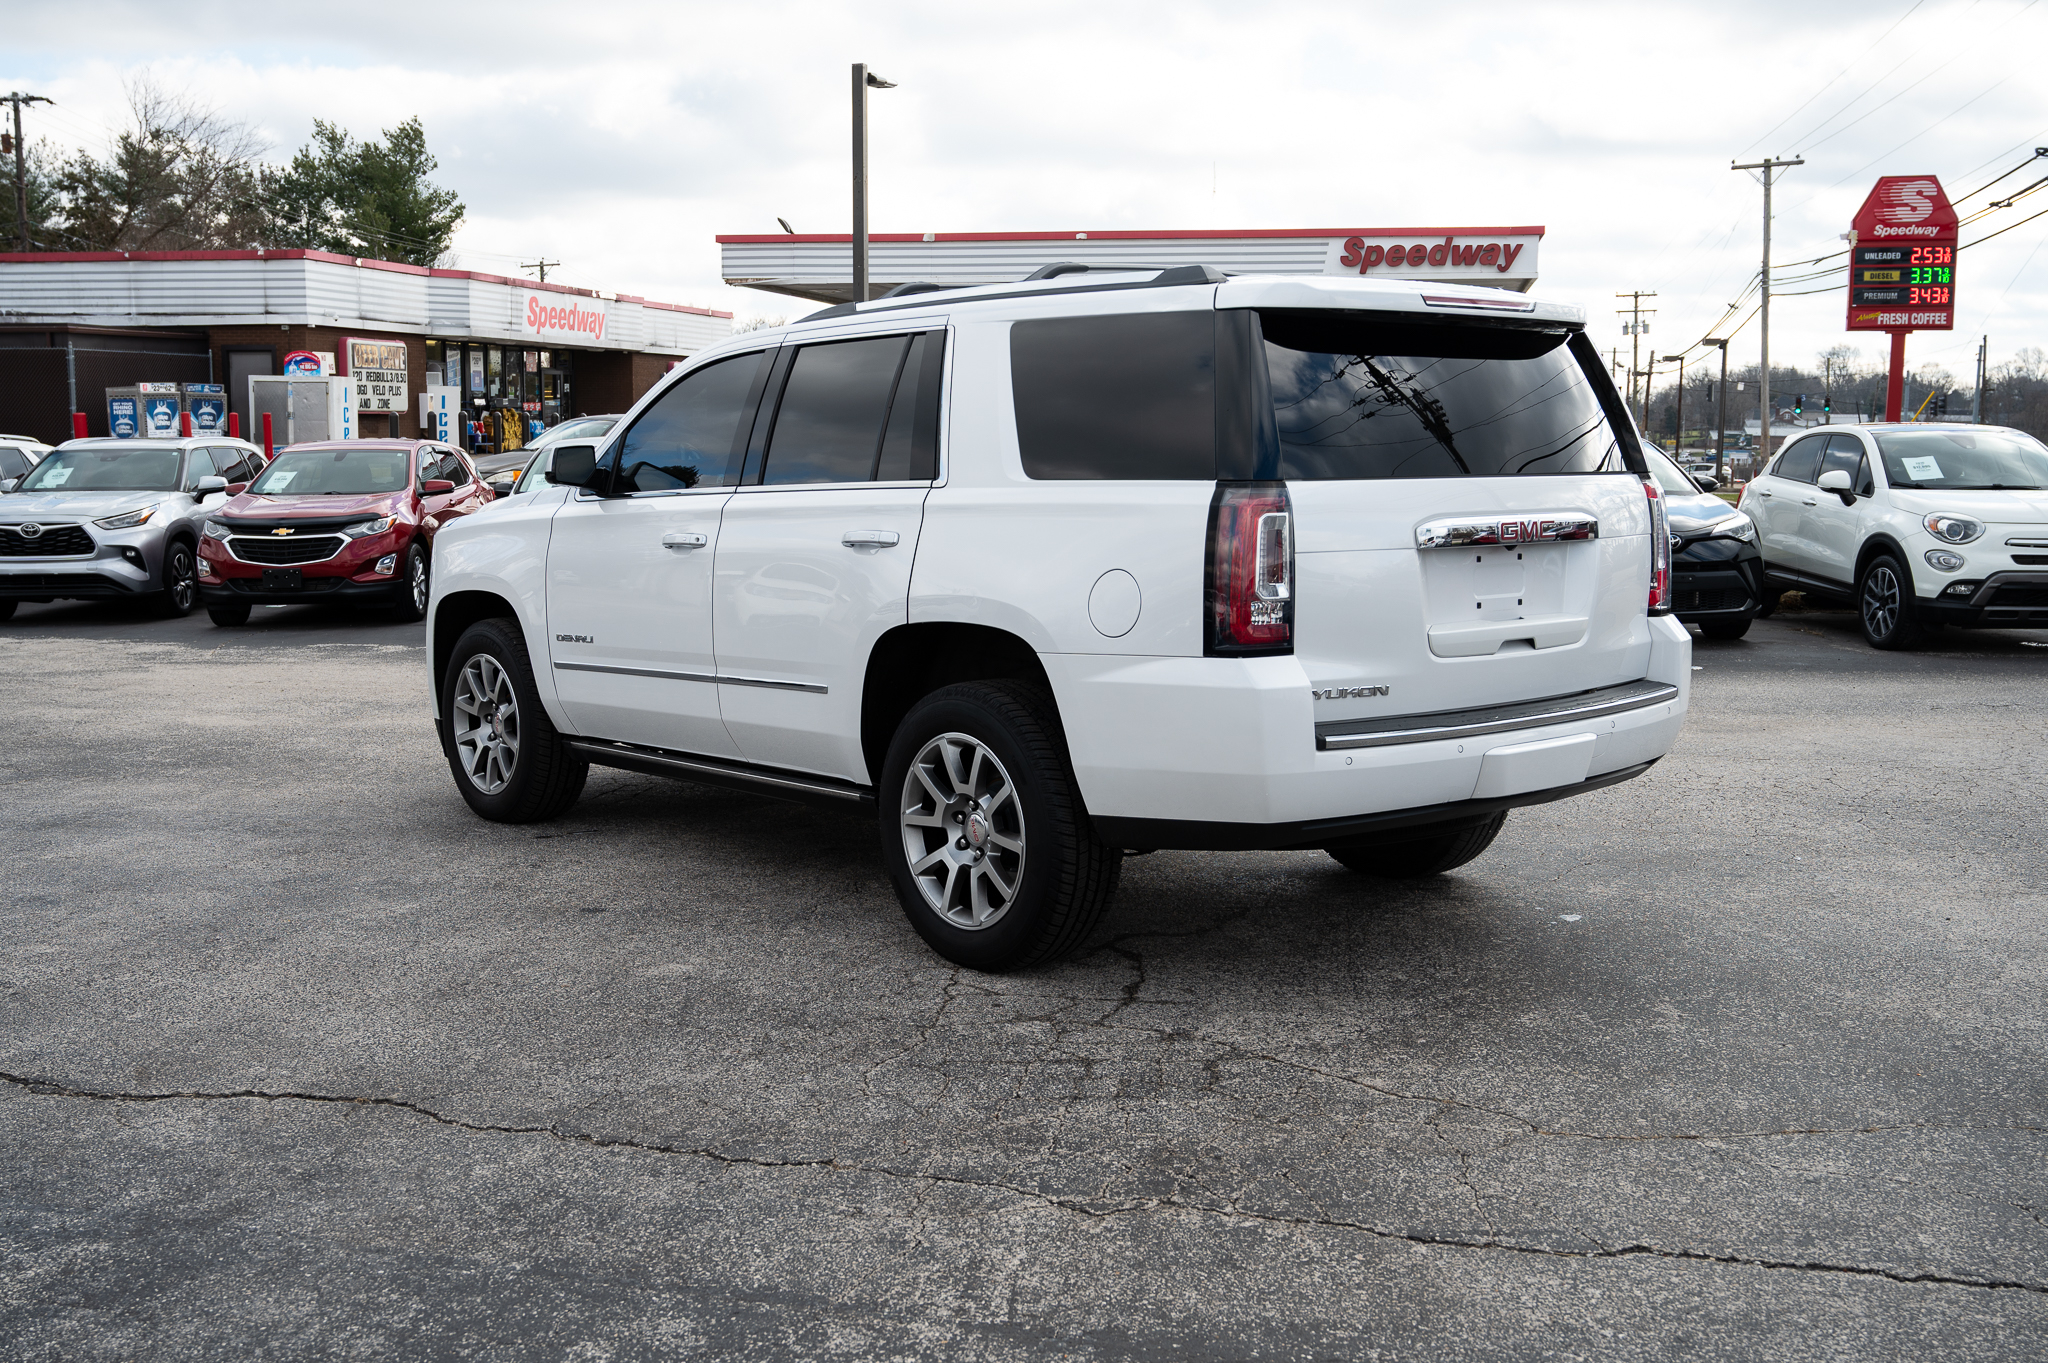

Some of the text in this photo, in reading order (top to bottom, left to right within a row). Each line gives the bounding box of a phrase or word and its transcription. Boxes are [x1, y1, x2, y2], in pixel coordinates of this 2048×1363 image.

[1873, 224, 1940, 237] Speedway
[1340, 236, 1524, 275] Speedway
[1864, 252, 1901, 260] UNLEADED
[1910, 247, 1943, 264] 2.53
[1870, 272, 1894, 280] DIESEL
[1910, 267, 1942, 284] 3.37
[1863, 292, 1898, 300] PREMIUM
[1909, 287, 1941, 304] 3.43
[527, 295, 605, 340] Speedway
[1877, 313, 1909, 325] FRESH
[1911, 312, 1947, 325] COFFEE
[354, 344, 405, 369] BEER CAVE
[372, 384, 386, 396] VELO
[388, 385, 402, 396] PLUS
[359, 398, 391, 409] AND ZONE
[1499, 520, 1555, 542] GMC
[556, 633, 594, 644] DENALI
[1311, 684, 1390, 701] YUKON
